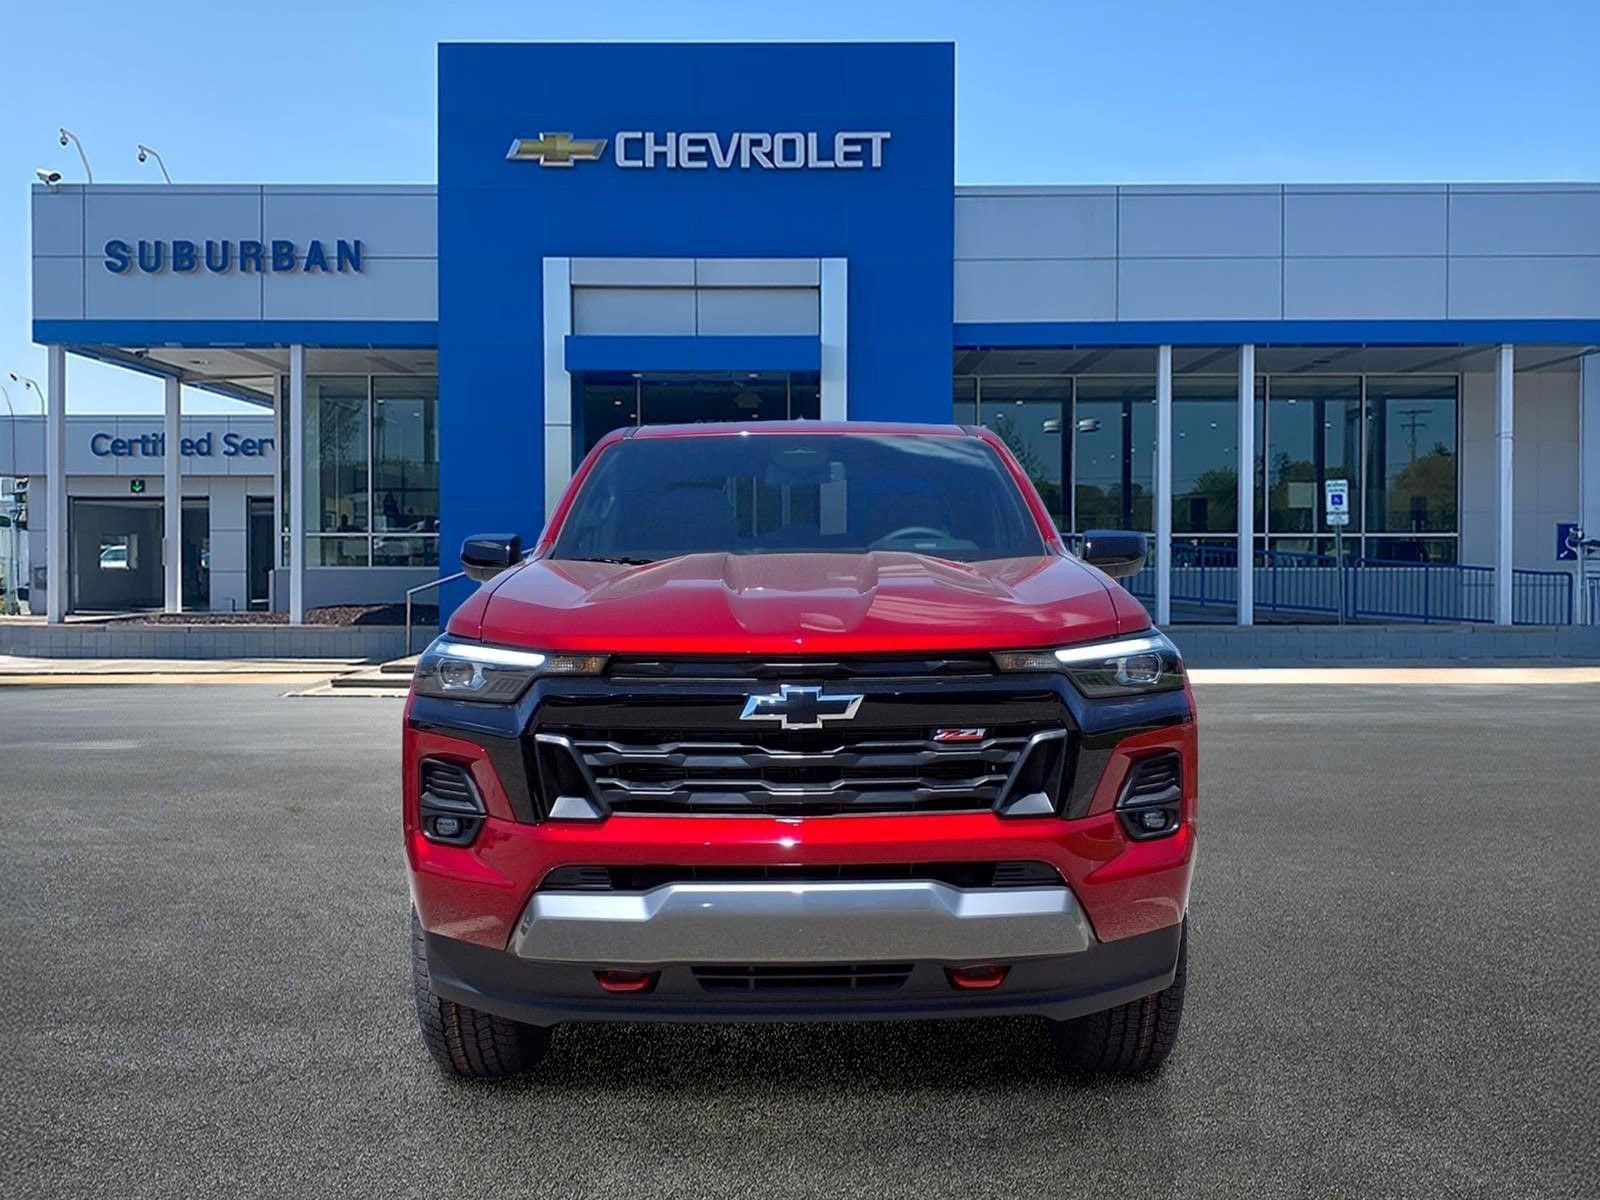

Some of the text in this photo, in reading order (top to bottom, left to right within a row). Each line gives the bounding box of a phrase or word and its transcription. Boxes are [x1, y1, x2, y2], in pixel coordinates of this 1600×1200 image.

[615, 131, 891, 168] CHEVROLET
[104, 239, 363, 274] SUBURBAN
[90, 432, 213, 457] Certifed
